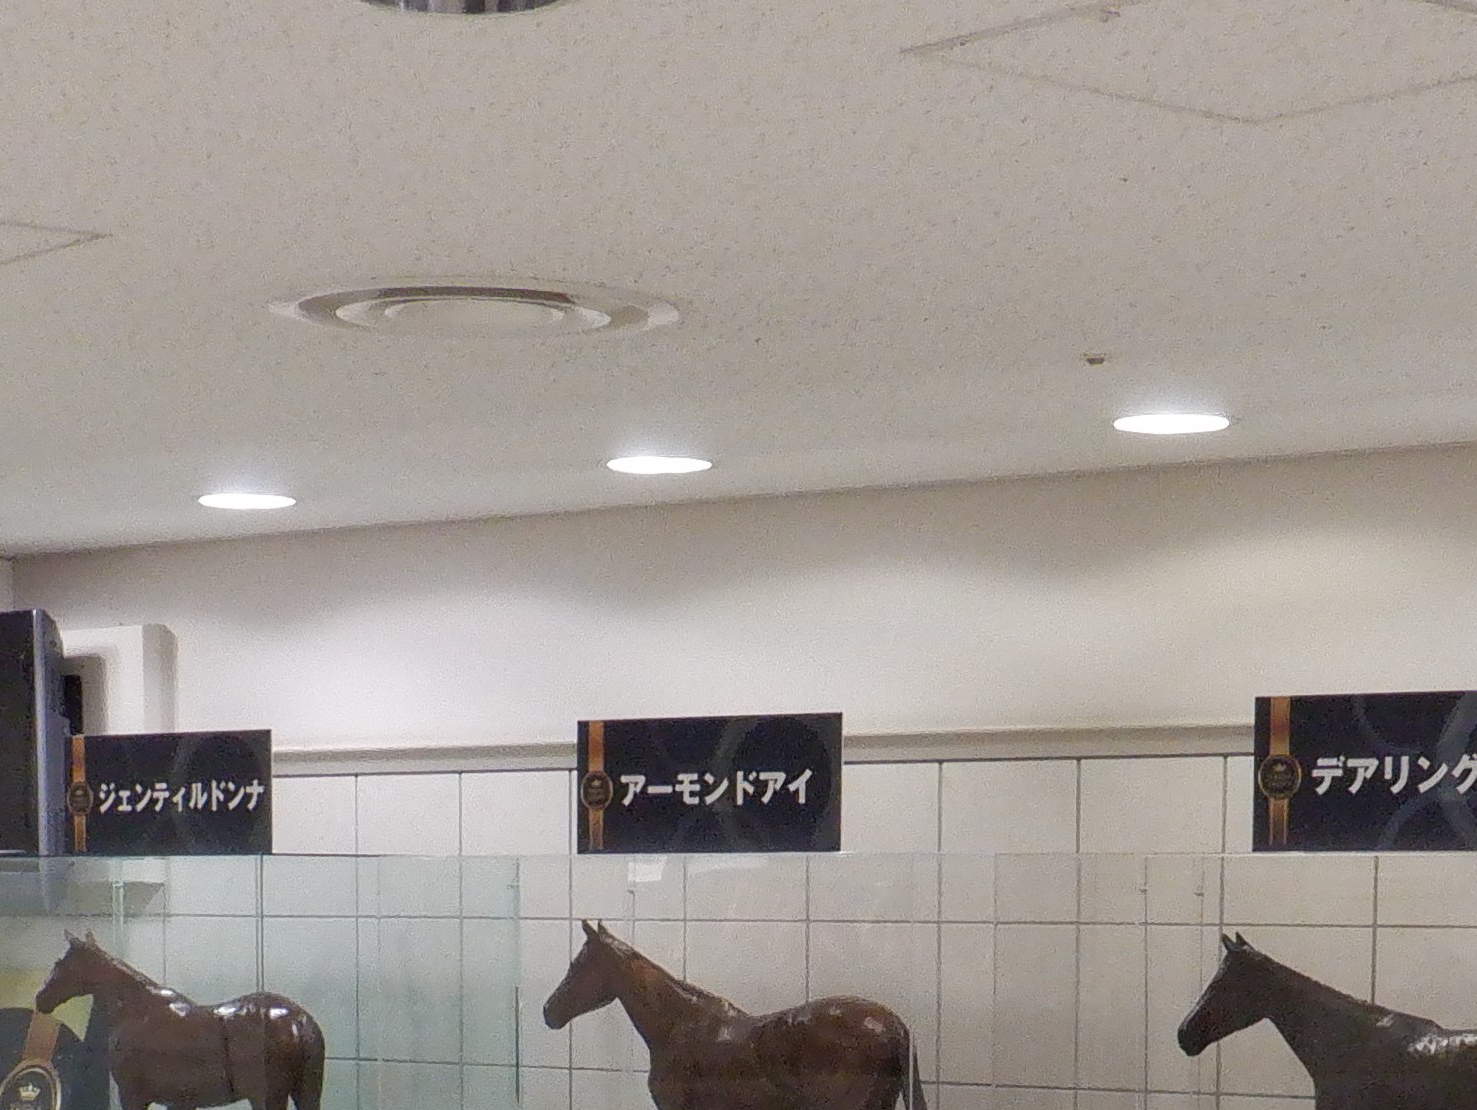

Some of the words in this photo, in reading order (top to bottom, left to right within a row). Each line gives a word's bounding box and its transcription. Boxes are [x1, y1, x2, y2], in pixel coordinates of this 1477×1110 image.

[98, 778, 265, 814] ジェンティルドンナ
[619, 768, 814, 807] アーモンドアイ
